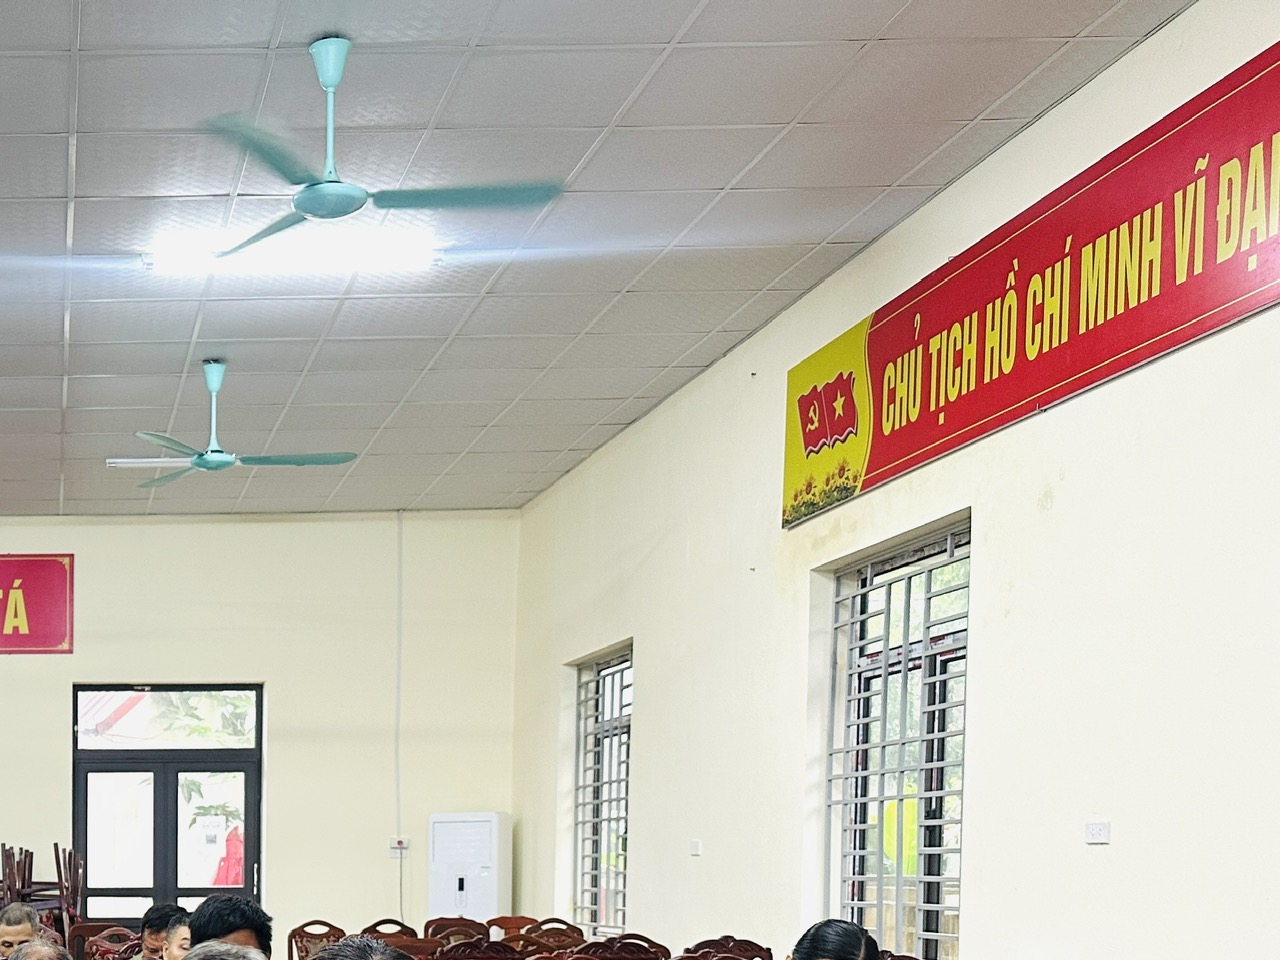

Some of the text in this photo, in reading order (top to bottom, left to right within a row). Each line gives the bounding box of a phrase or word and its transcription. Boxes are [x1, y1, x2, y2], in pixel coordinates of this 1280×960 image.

[881, 131, 1280, 436] CHỦ TỊCH HỒ CHÍ MINH VĨ ĐẠI
